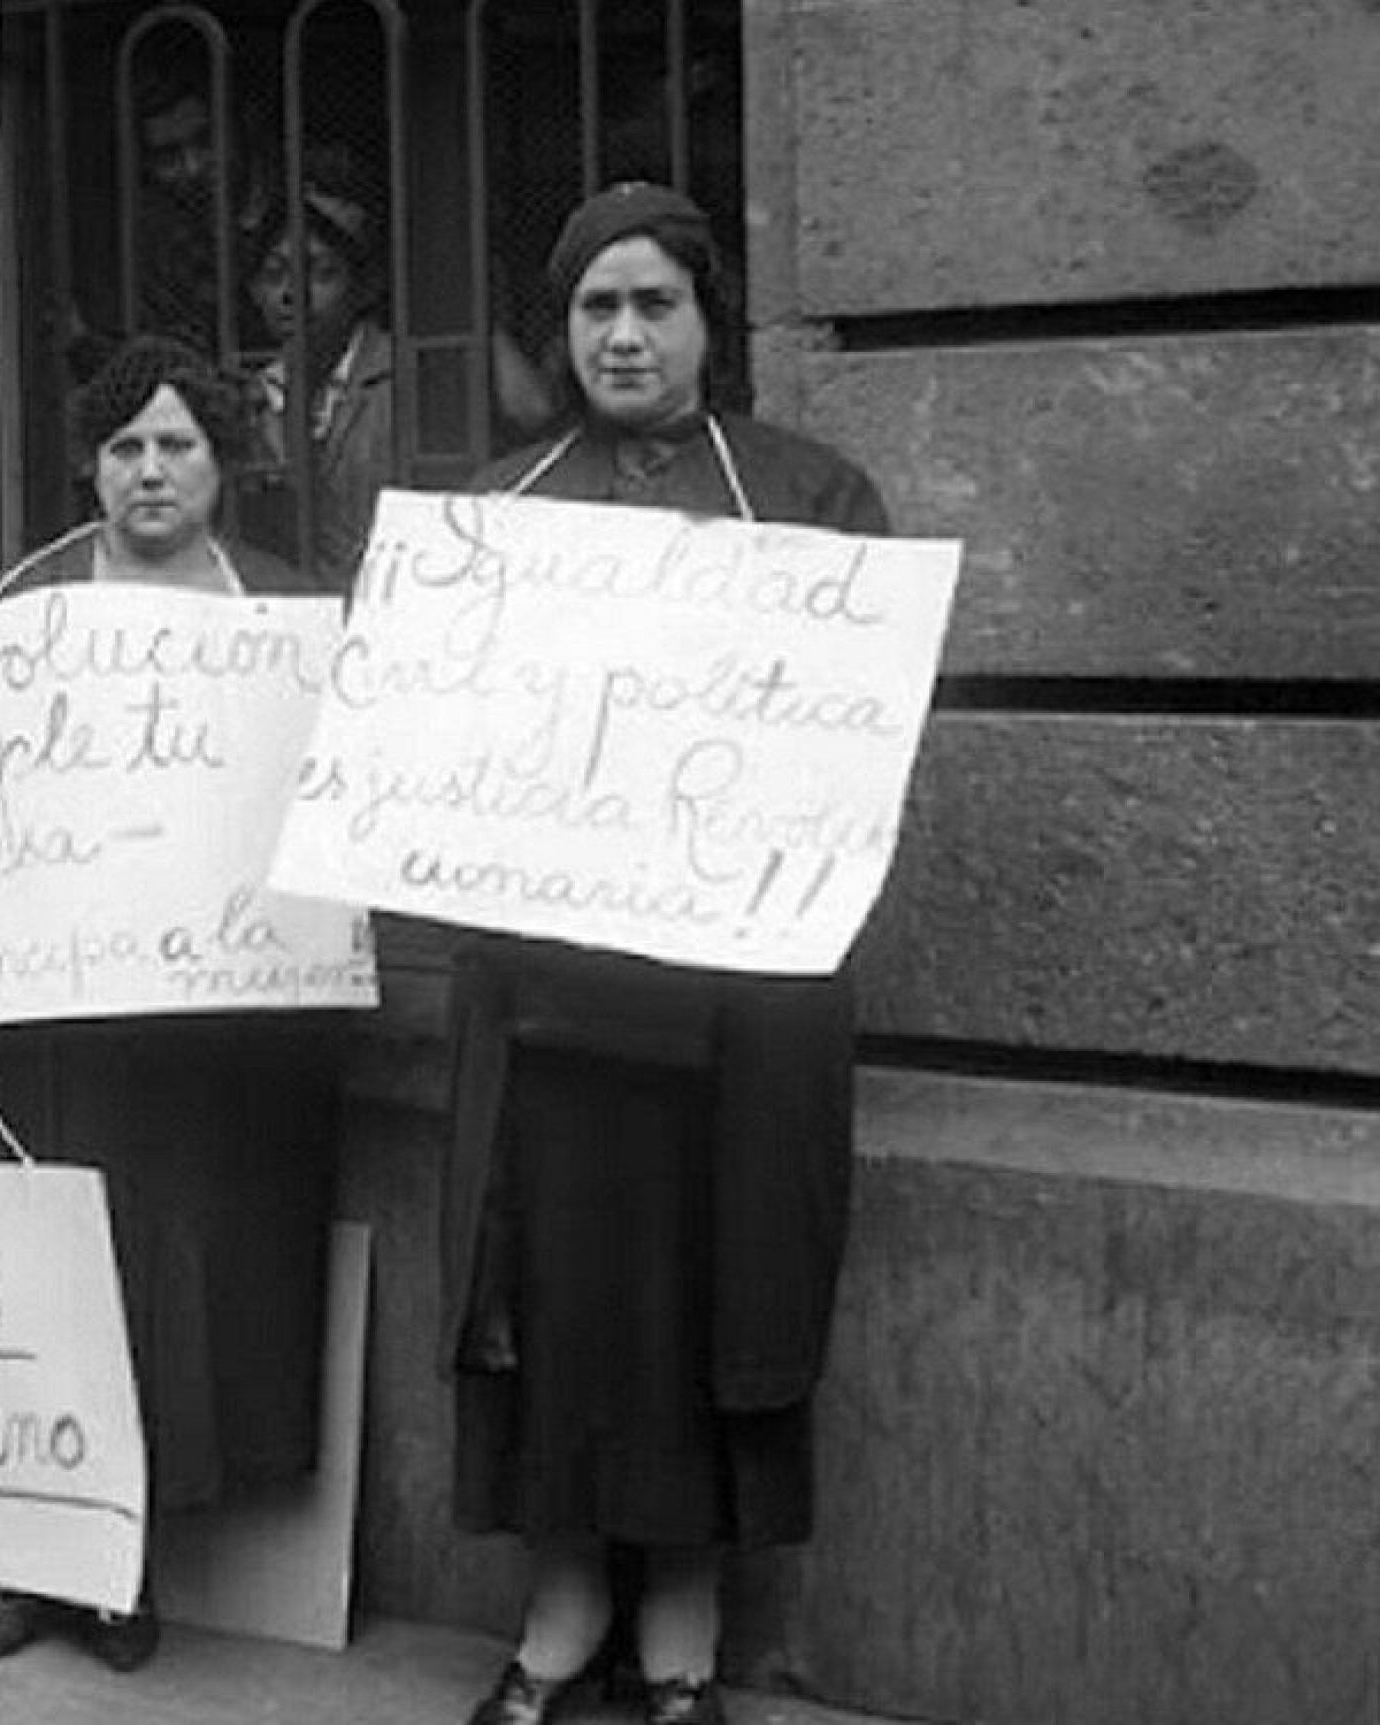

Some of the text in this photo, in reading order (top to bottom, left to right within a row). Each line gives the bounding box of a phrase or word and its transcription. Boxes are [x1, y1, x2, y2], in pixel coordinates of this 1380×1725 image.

[126, 680, 226, 773] tu
[157, 924, 203, 964] a
[216, 882, 288, 953] la
